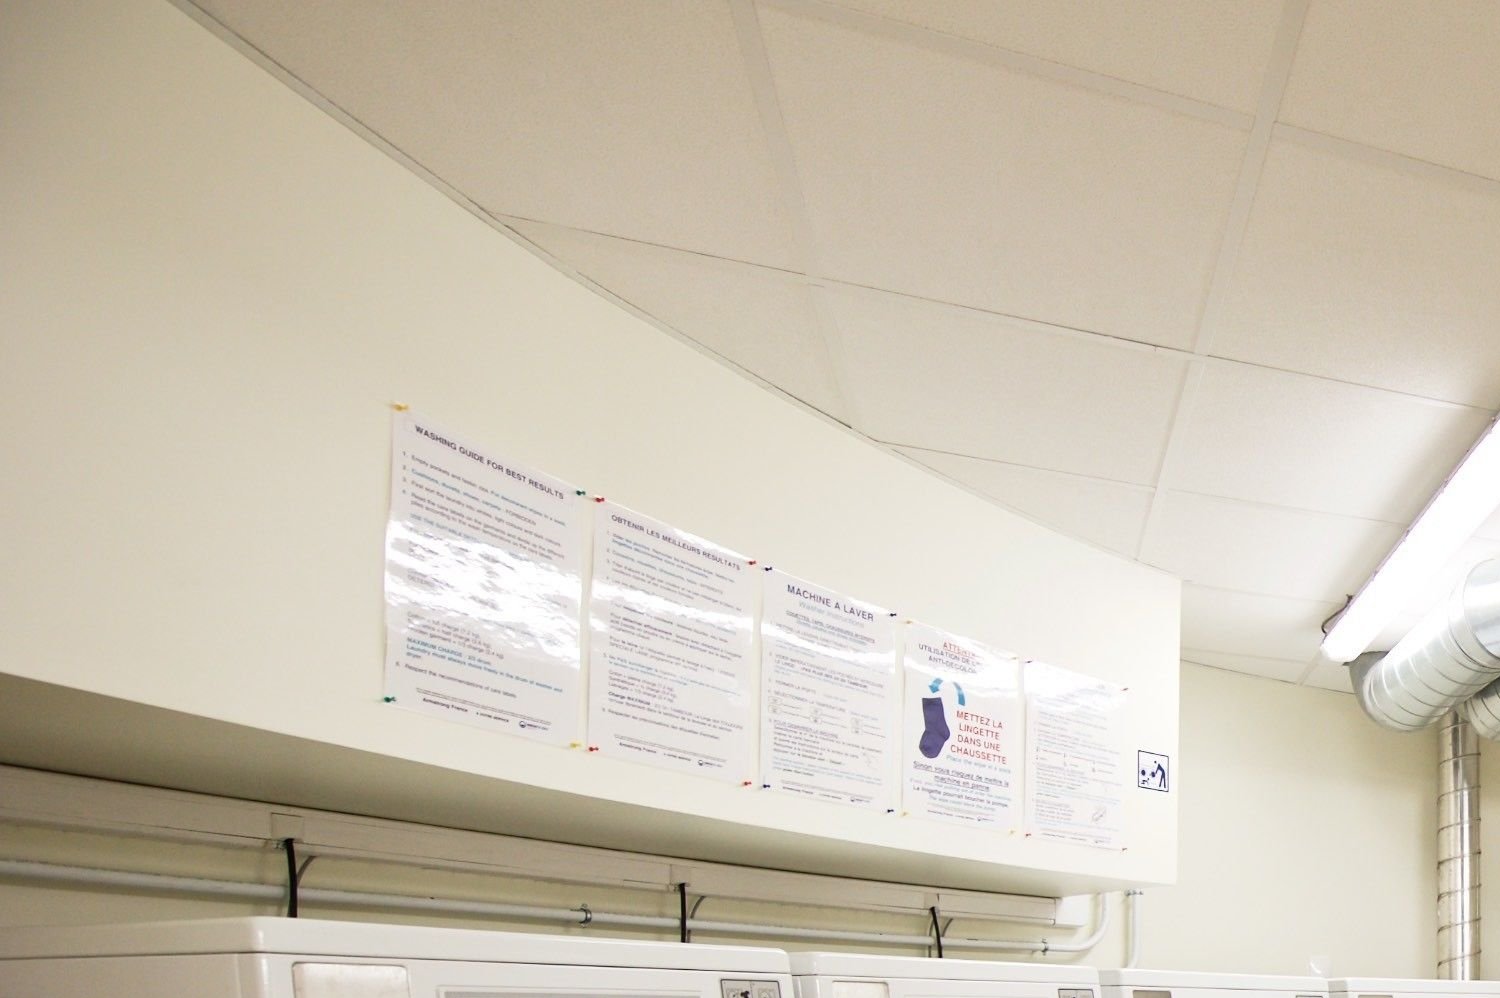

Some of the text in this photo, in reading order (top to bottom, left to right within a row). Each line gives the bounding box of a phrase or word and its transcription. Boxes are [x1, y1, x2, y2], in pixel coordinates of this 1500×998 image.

[416, 425, 564, 500] WASHING GUIDE FOR BEST RESULTS
[612, 515, 740, 570] OBTENIR LES MEILLEURS RESULTATS
[787, 584, 831, 608] MACHINE
[844, 605, 874, 622] LAVER
[919, 644, 959, 661] UTILISATION
[957, 710, 990, 726] METTEZ
[959, 723, 1000, 740] LINGETTE
[958, 734, 1000, 752] DANS UNE
[950, 745, 1007, 764] CHAUSSETTE
[913, 760, 932, 771] Sinon
